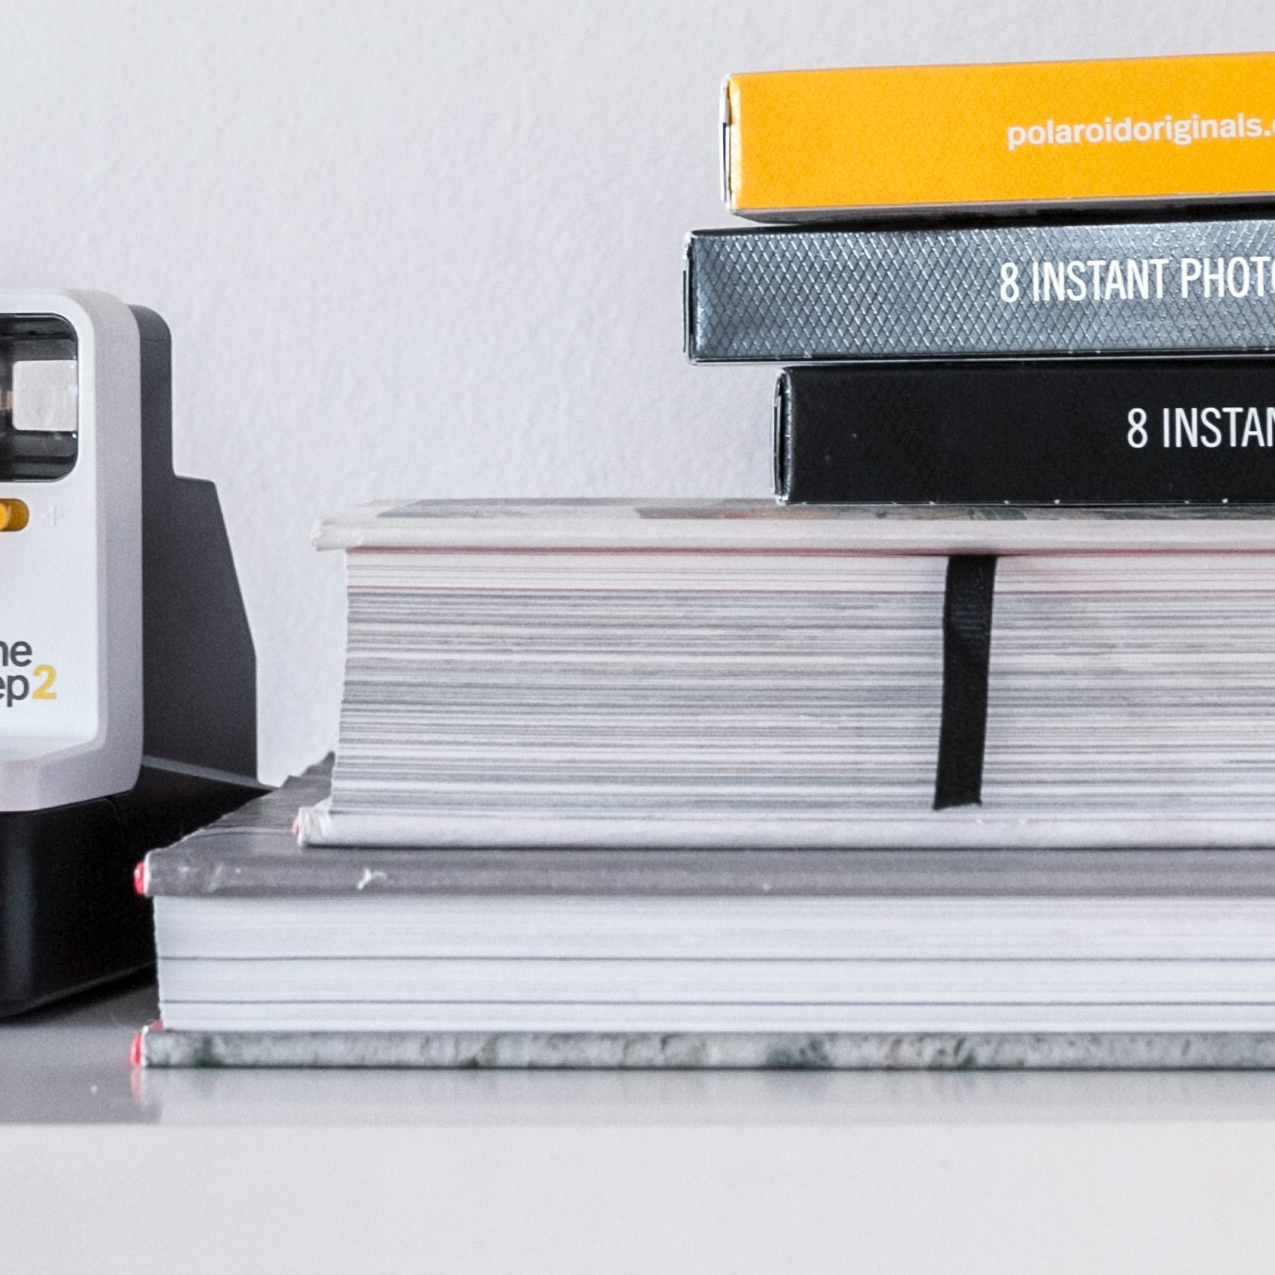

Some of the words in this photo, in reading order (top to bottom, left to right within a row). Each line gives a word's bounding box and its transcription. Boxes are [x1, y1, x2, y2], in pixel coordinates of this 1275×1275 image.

[1000, 262, 1020, 303] 8
[1032, 258, 1170, 302] INSTANT
[1127, 407, 1148, 449] 8
